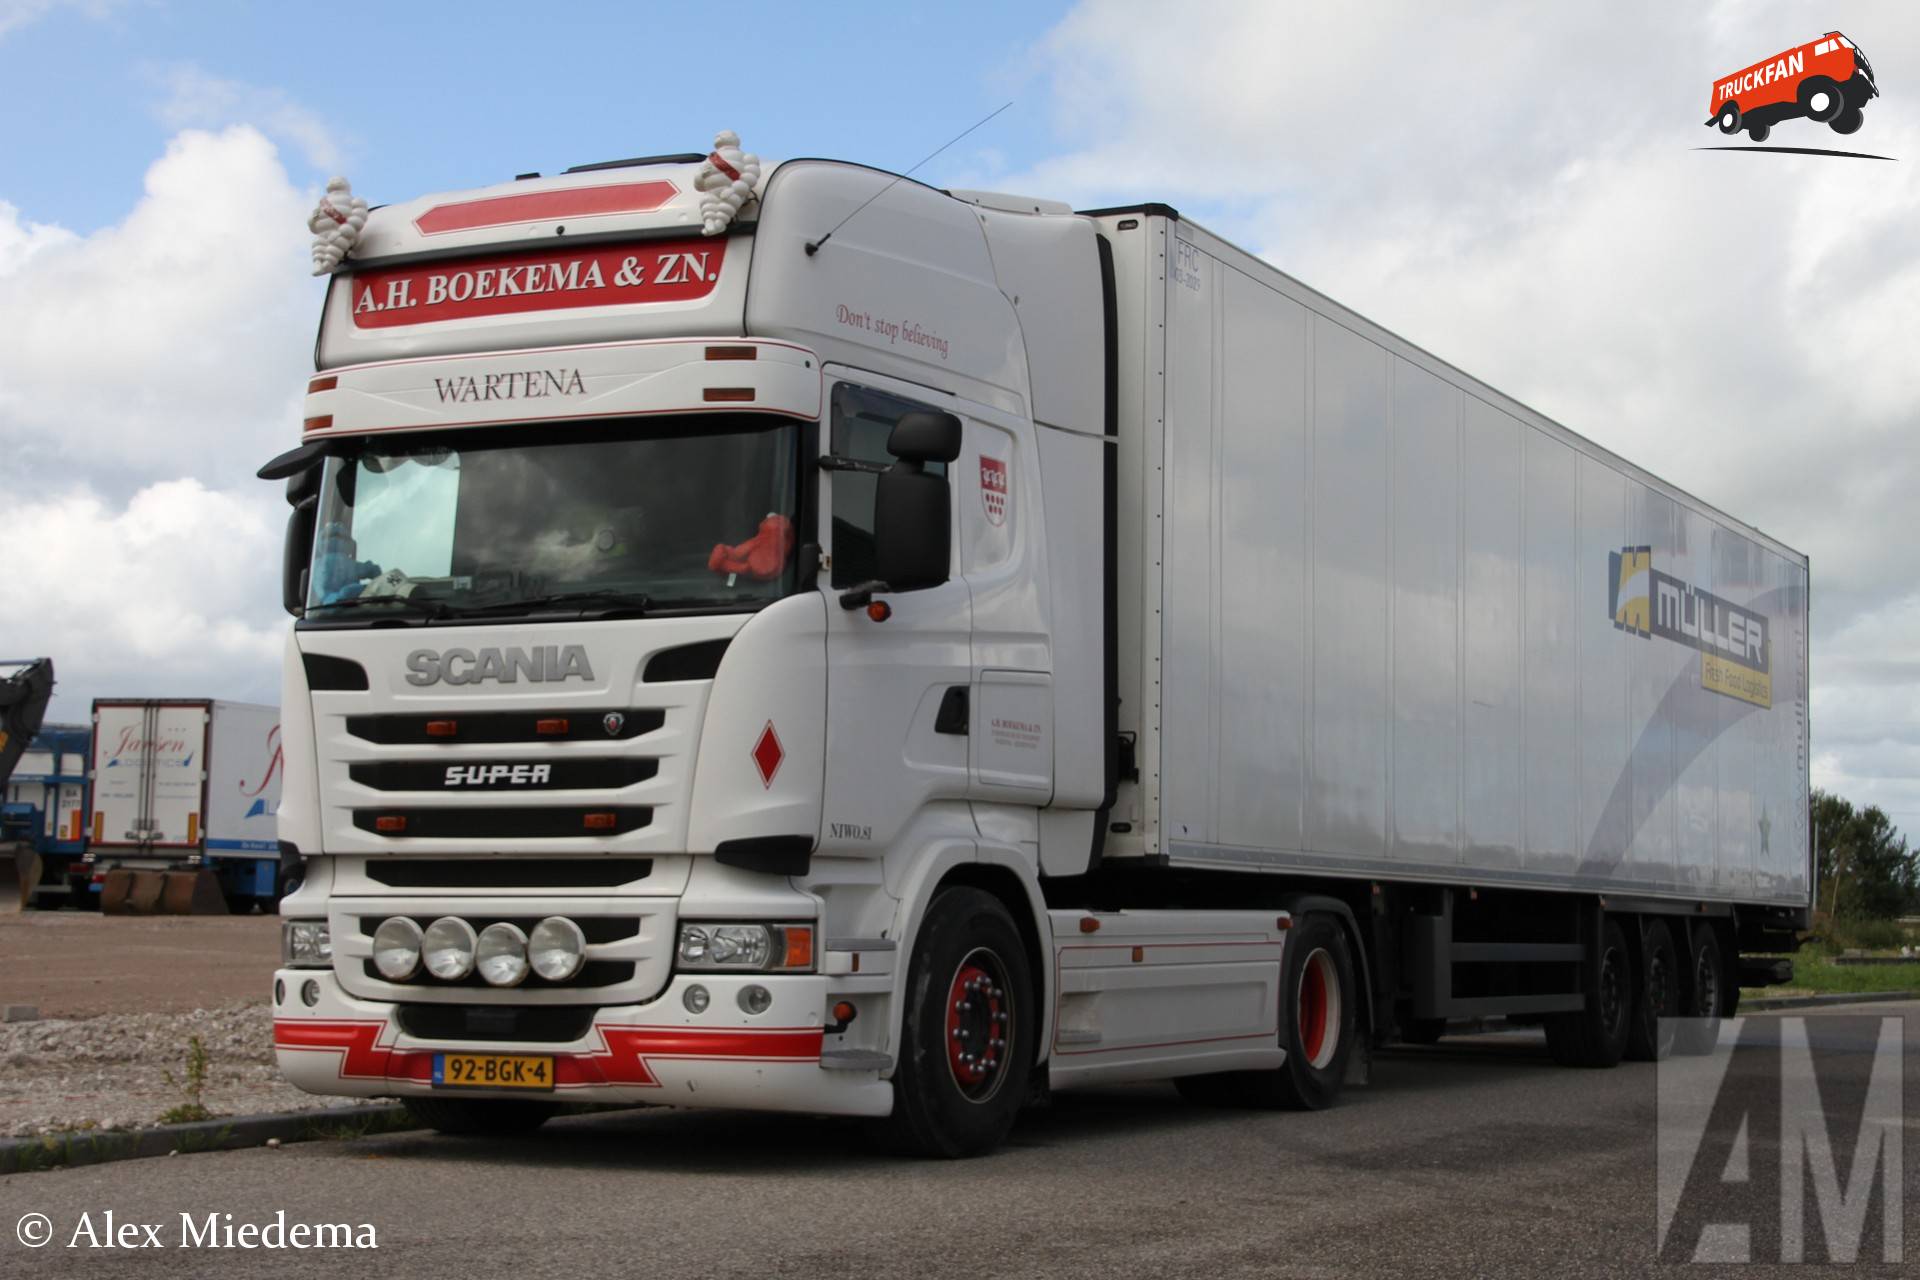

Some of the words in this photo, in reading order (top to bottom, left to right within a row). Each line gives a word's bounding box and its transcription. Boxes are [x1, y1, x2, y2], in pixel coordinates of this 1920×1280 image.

[1178, 240, 1199, 272] FRC
[354, 276, 417, 315] A.H.
[425, 258, 606, 306] BOEKEMA
[613, 255, 645, 289] &
[652, 251, 718, 285] ZN.
[836, 303, 871, 331] Don't
[874, 318, 899, 345] stop
[901, 319, 949, 360] believing
[434, 367, 588, 404] WARTENA
[1657, 579, 1763, 665] MÜLLER
[404, 644, 596, 687] SCANIA
[444, 764, 552, 786] SUPER
[450, 1058, 547, 1083] 92-BGK-4
